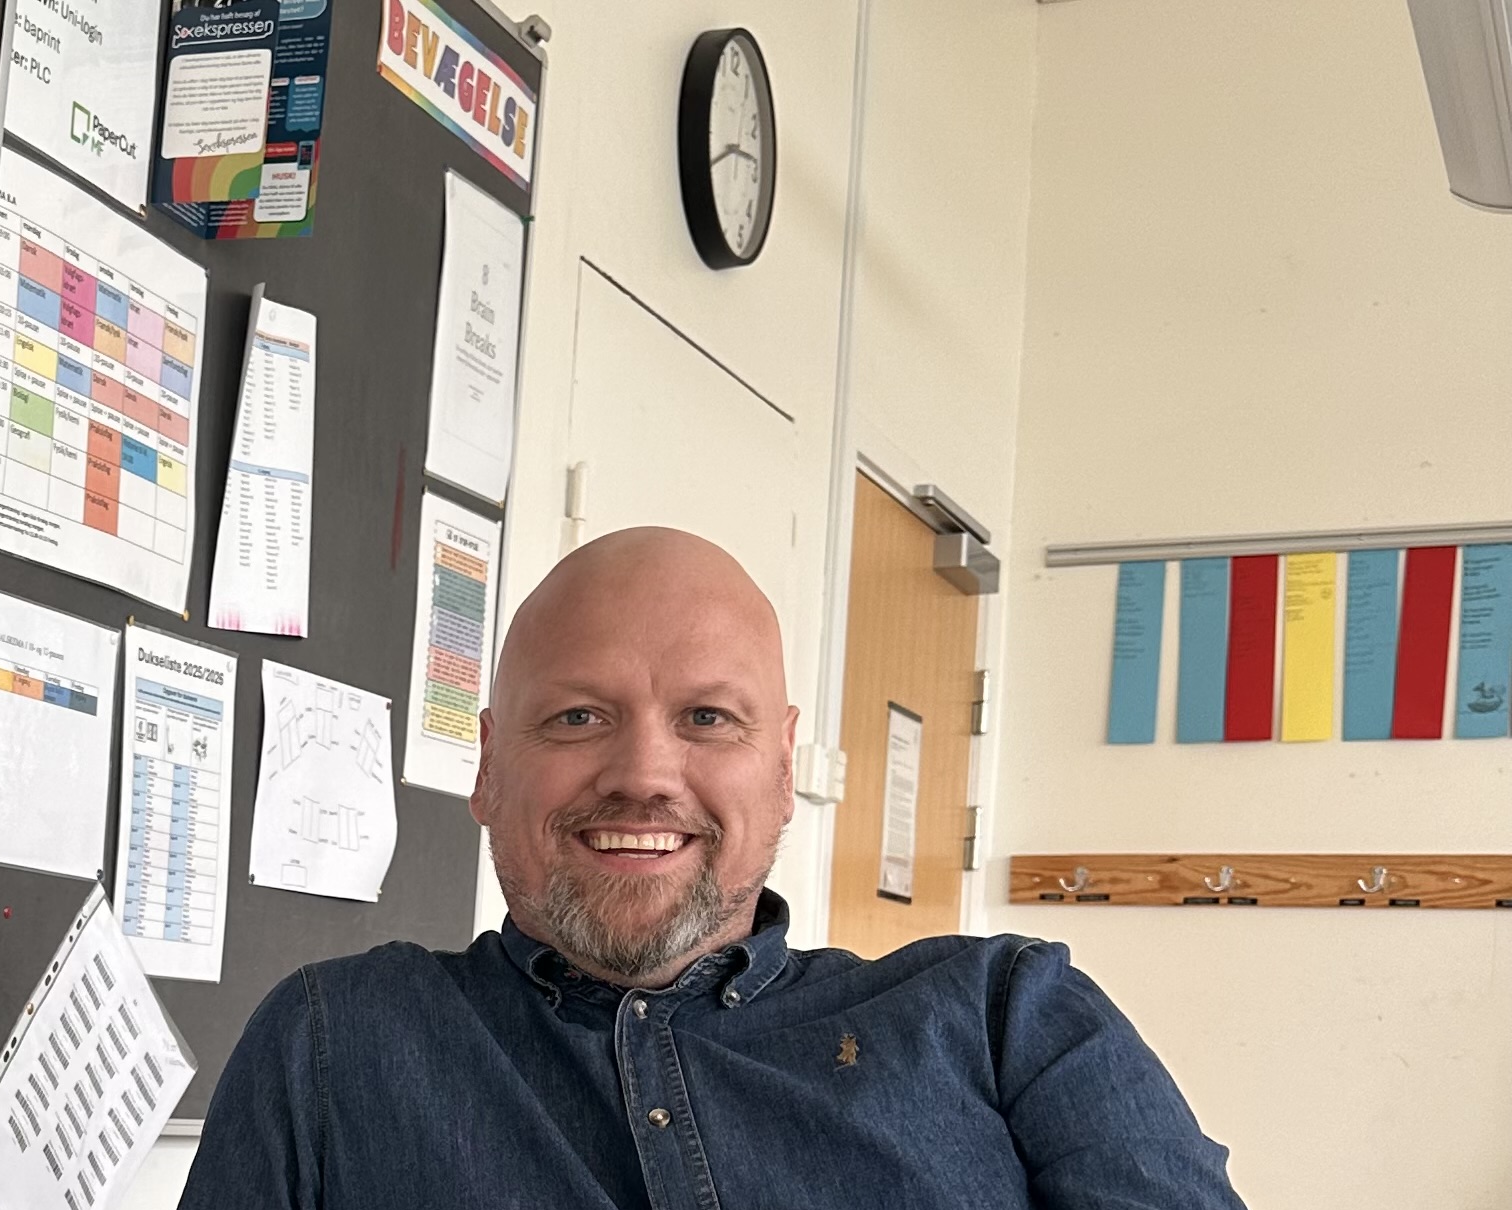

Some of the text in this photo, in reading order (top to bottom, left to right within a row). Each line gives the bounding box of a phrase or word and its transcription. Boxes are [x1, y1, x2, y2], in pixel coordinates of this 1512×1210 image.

[23, 15, 61, 54] baprint
[60, 4, 103, 46] Uni-login
[30, 57, 51, 84] PLC
[387, 0, 529, 160] BEVÆGELSE
[92, 114, 137, 160] PaperCut
[470, 290, 496, 325] Brain
[137, 646, 182, 674] Dukseliste
